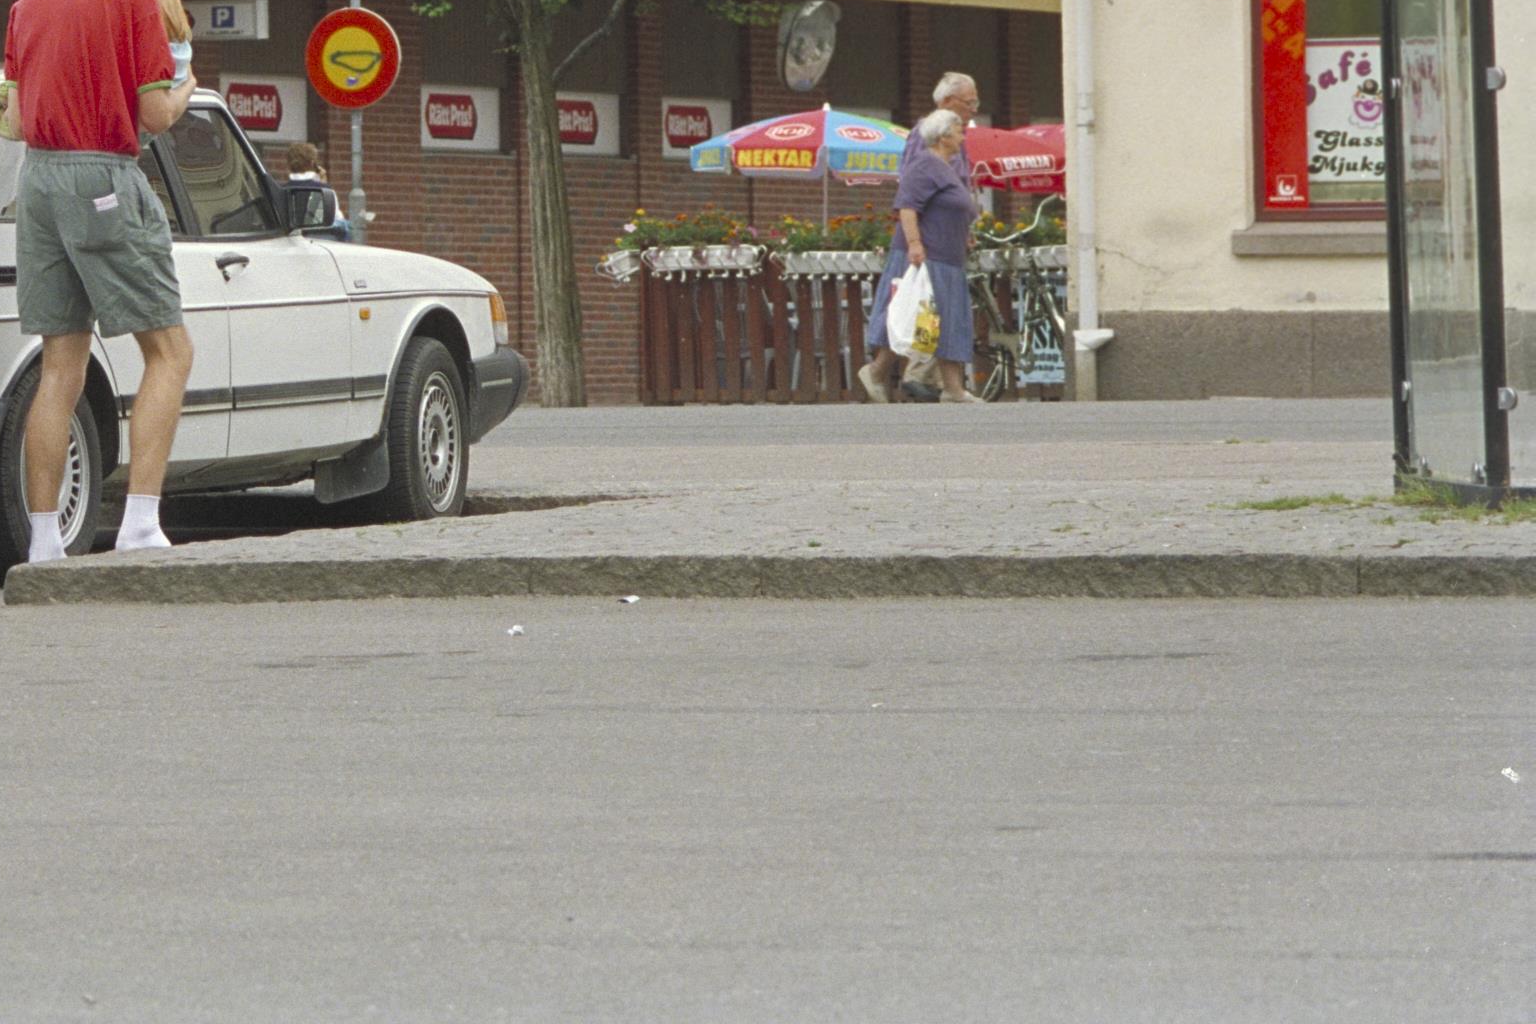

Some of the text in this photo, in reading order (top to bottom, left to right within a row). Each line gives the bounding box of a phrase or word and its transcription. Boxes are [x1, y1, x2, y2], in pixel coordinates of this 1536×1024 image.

[229, 93, 278, 119] Rätt Pris!
[429, 102, 473, 128] Rätt Pris!
[572, 109, 594, 133] Pris!
[1314, 129, 1386, 153] Glass
[737, 148, 814, 167] NEKTAR
